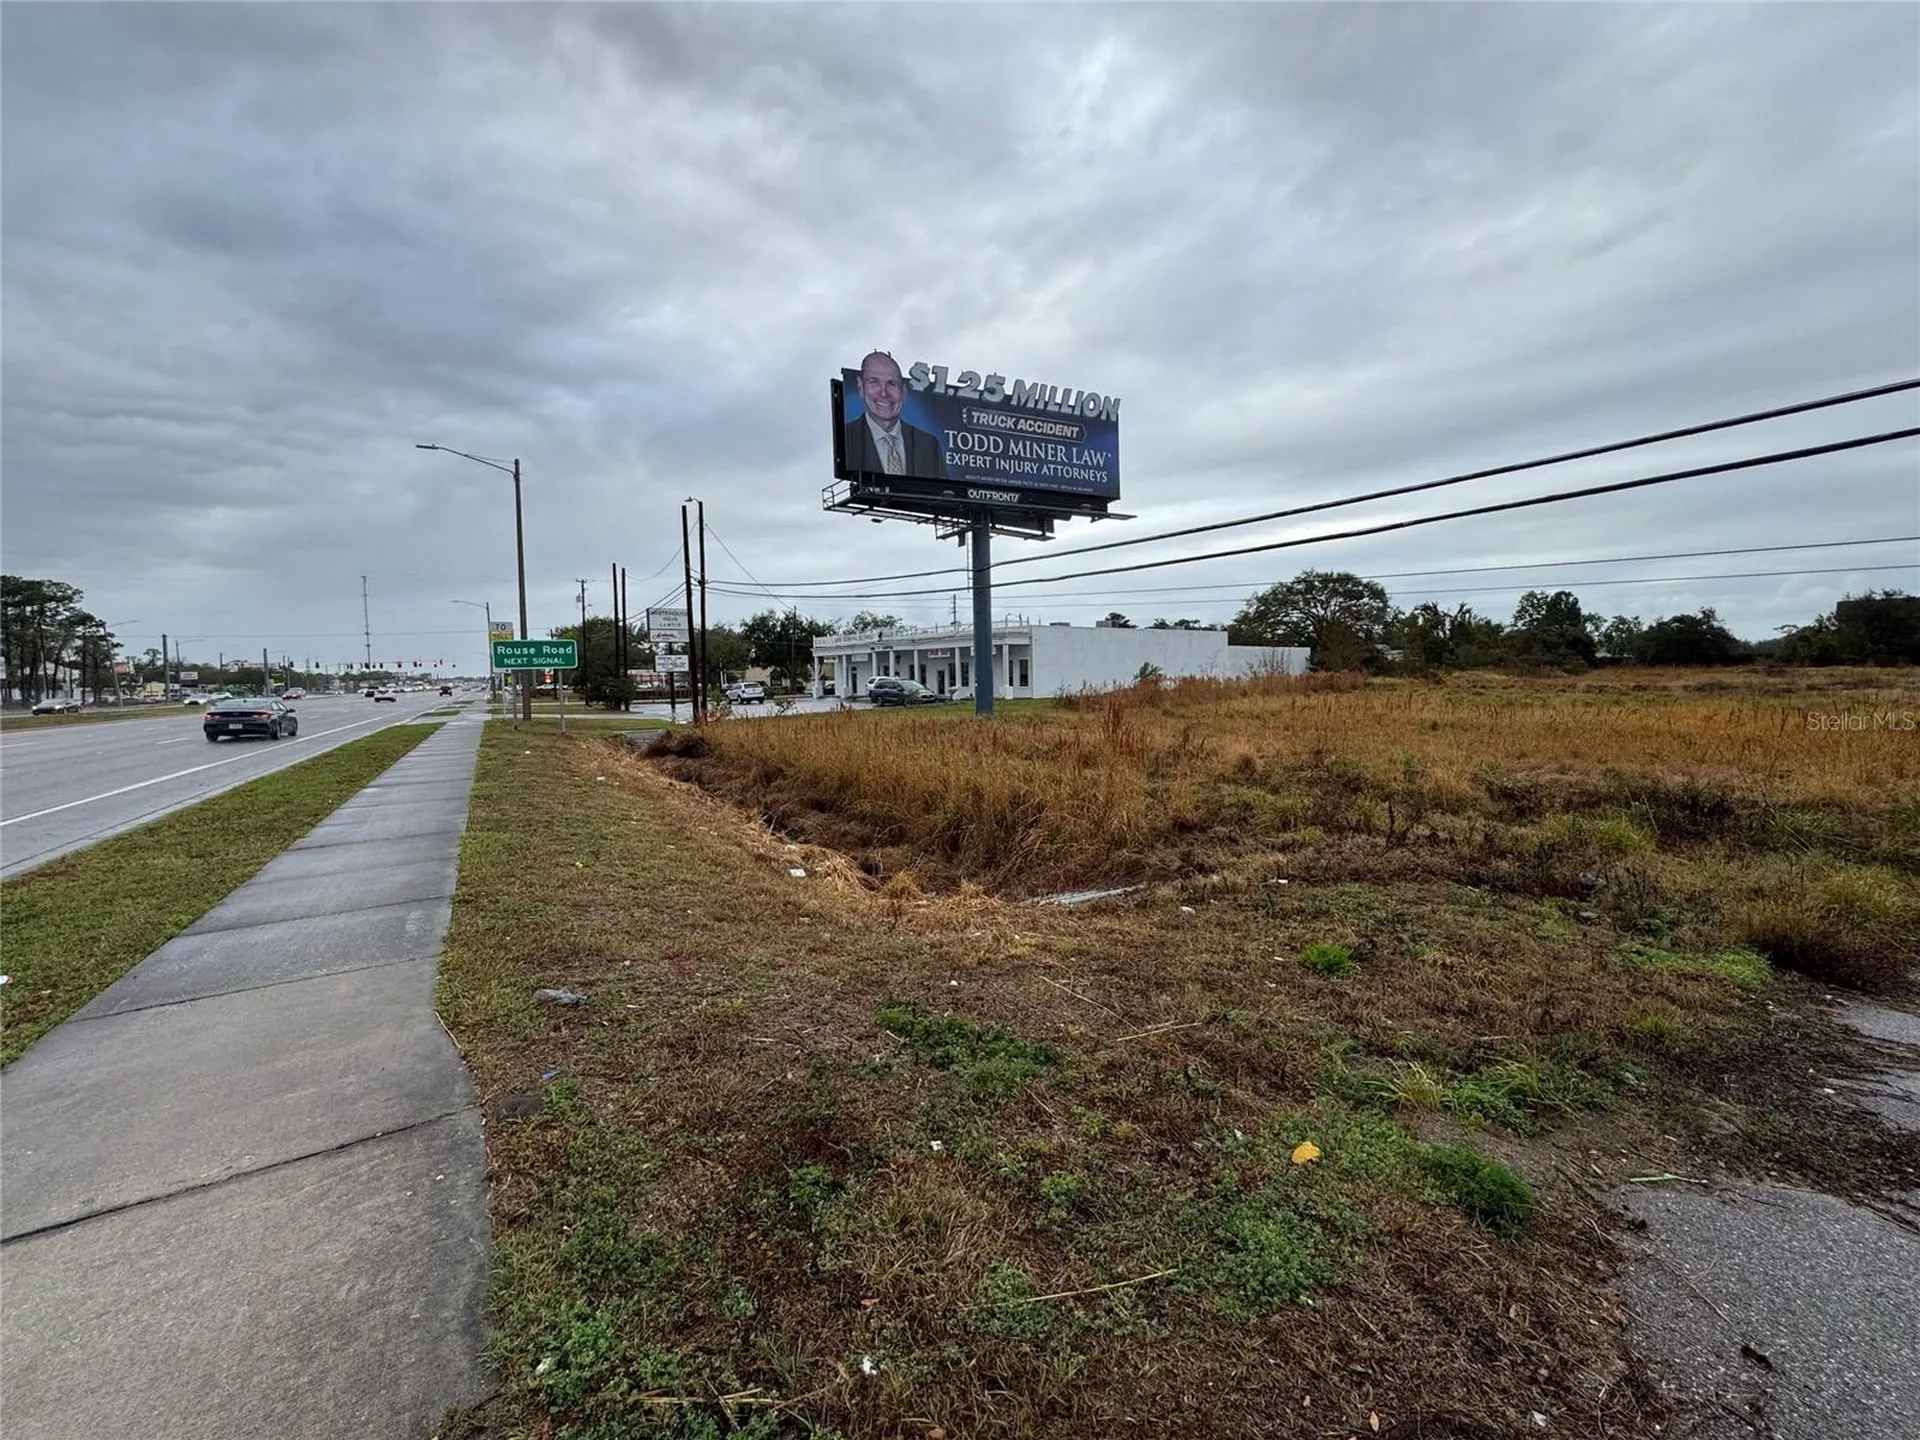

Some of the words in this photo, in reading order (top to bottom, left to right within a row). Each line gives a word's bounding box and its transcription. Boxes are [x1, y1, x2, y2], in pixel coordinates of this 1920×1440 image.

[909, 361, 1006, 403] $1.25
[1010, 379, 1121, 421] MILLION
[971, 411, 1016, 428] TRUCK
[1017, 419, 1079, 438] ACCIDENT
[944, 430, 1003, 454] TODD
[1009, 439, 1068, 463] MINER
[945, 452, 992, 468] EXPERT
[995, 458, 1039, 475] INJURY
[1041, 464, 1108, 483] ATTORNEYS
[495, 623, 506, 631] TO
[497, 645, 536, 655] Rouse
[542, 645, 573, 654] Road
[503, 657, 528, 665] NEXT
[532, 657, 565, 665] SIGNAL
